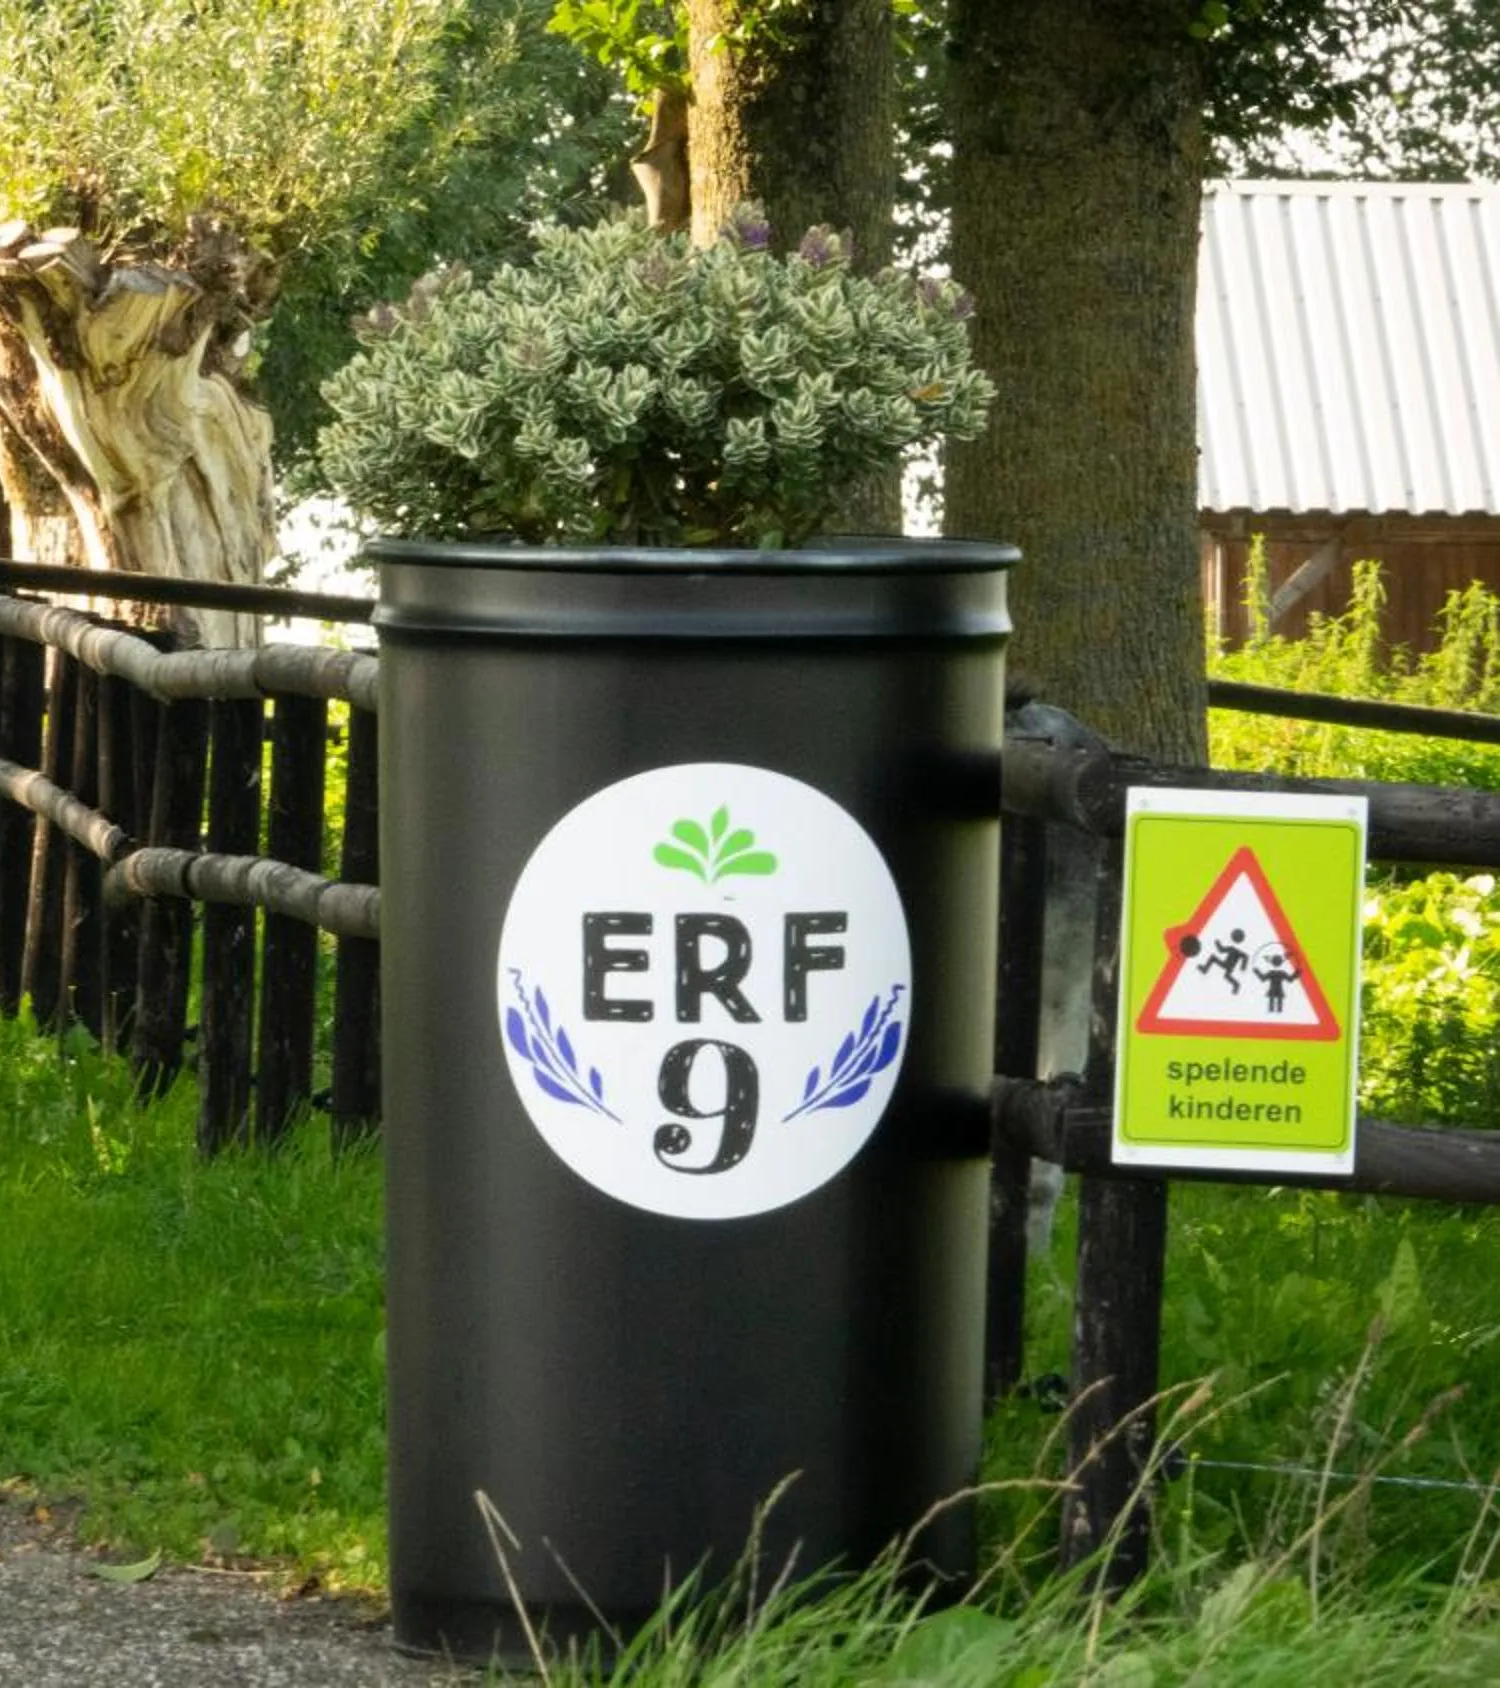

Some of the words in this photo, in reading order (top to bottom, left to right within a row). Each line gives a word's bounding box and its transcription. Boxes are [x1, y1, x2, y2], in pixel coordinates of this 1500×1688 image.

[582, 911, 849, 1023] ERF
[653, 1038, 760, 1174] 9
[1166, 1057, 1307, 1086] spelende
[1168, 1095, 1302, 1124] kinderen
